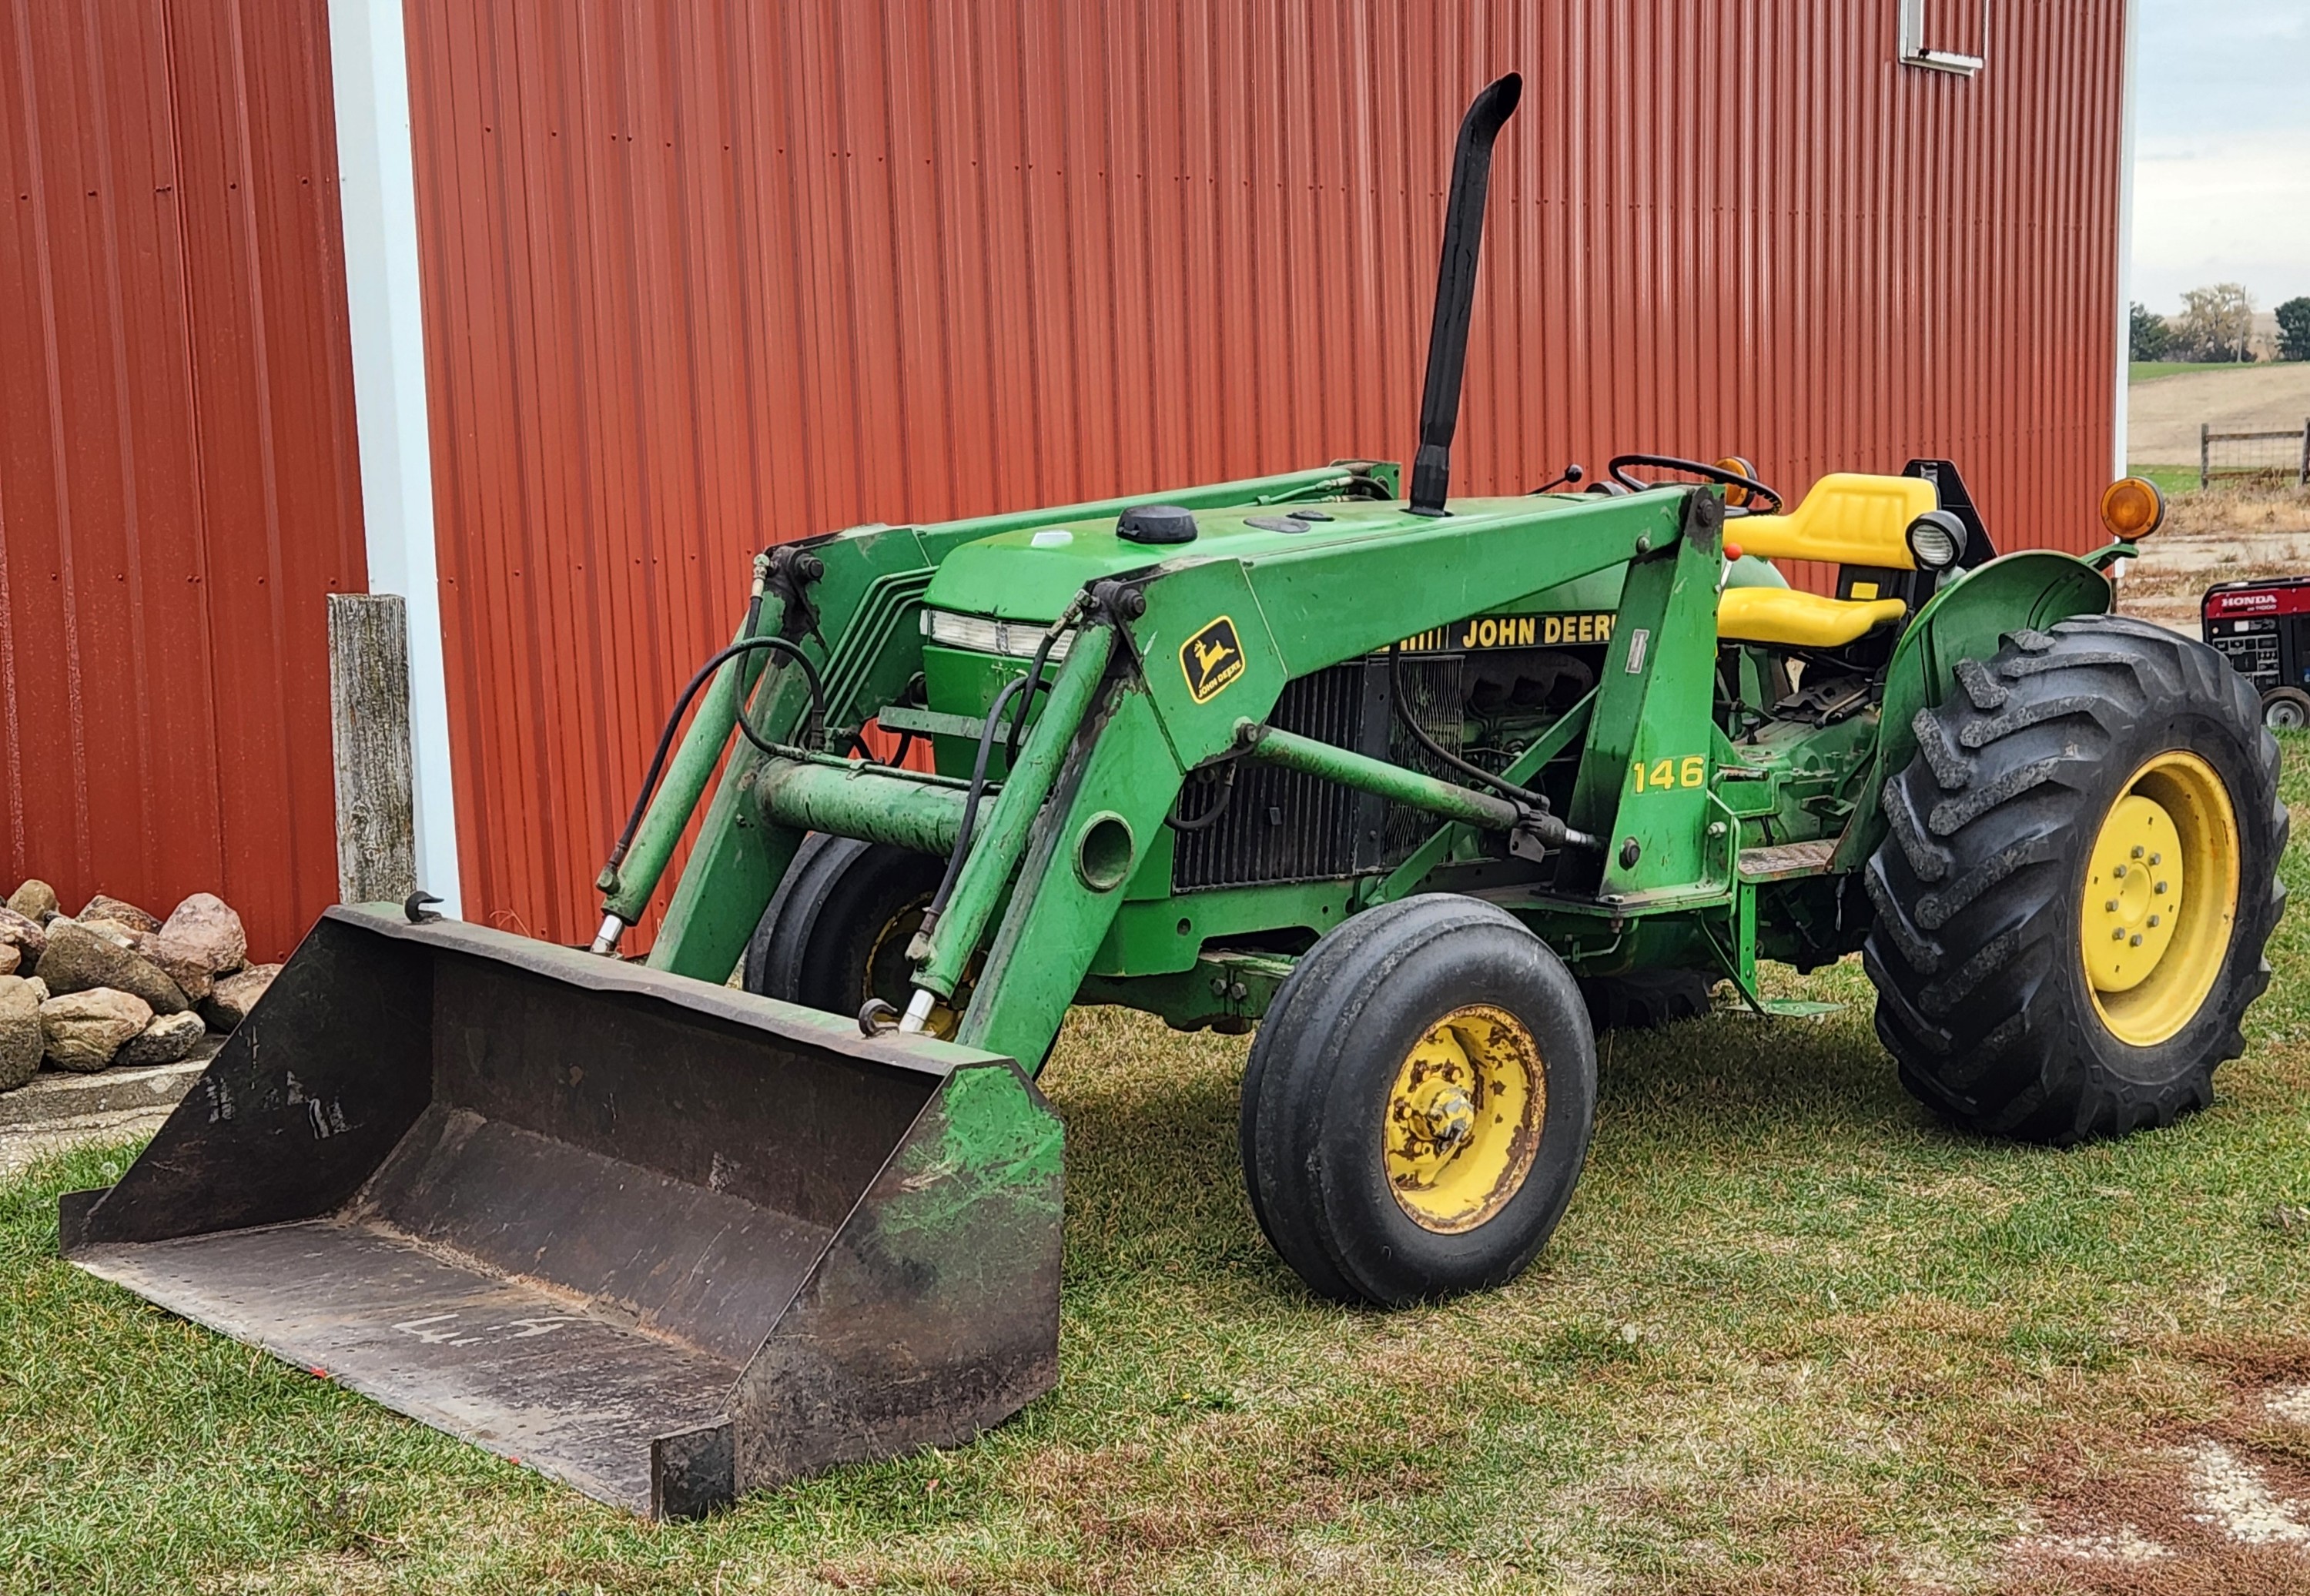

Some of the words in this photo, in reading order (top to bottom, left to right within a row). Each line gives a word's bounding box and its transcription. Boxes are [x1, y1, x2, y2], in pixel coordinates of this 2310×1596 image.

[2221, 594, 2278, 607] HONDA
[1463, 617, 1535, 648] JOHN
[1545, 614, 1617, 644] DEER
[1198, 678, 1218, 698] JOHN
[1217, 659, 1242, 683] DEERE
[1633, 756, 1705, 794] 146
